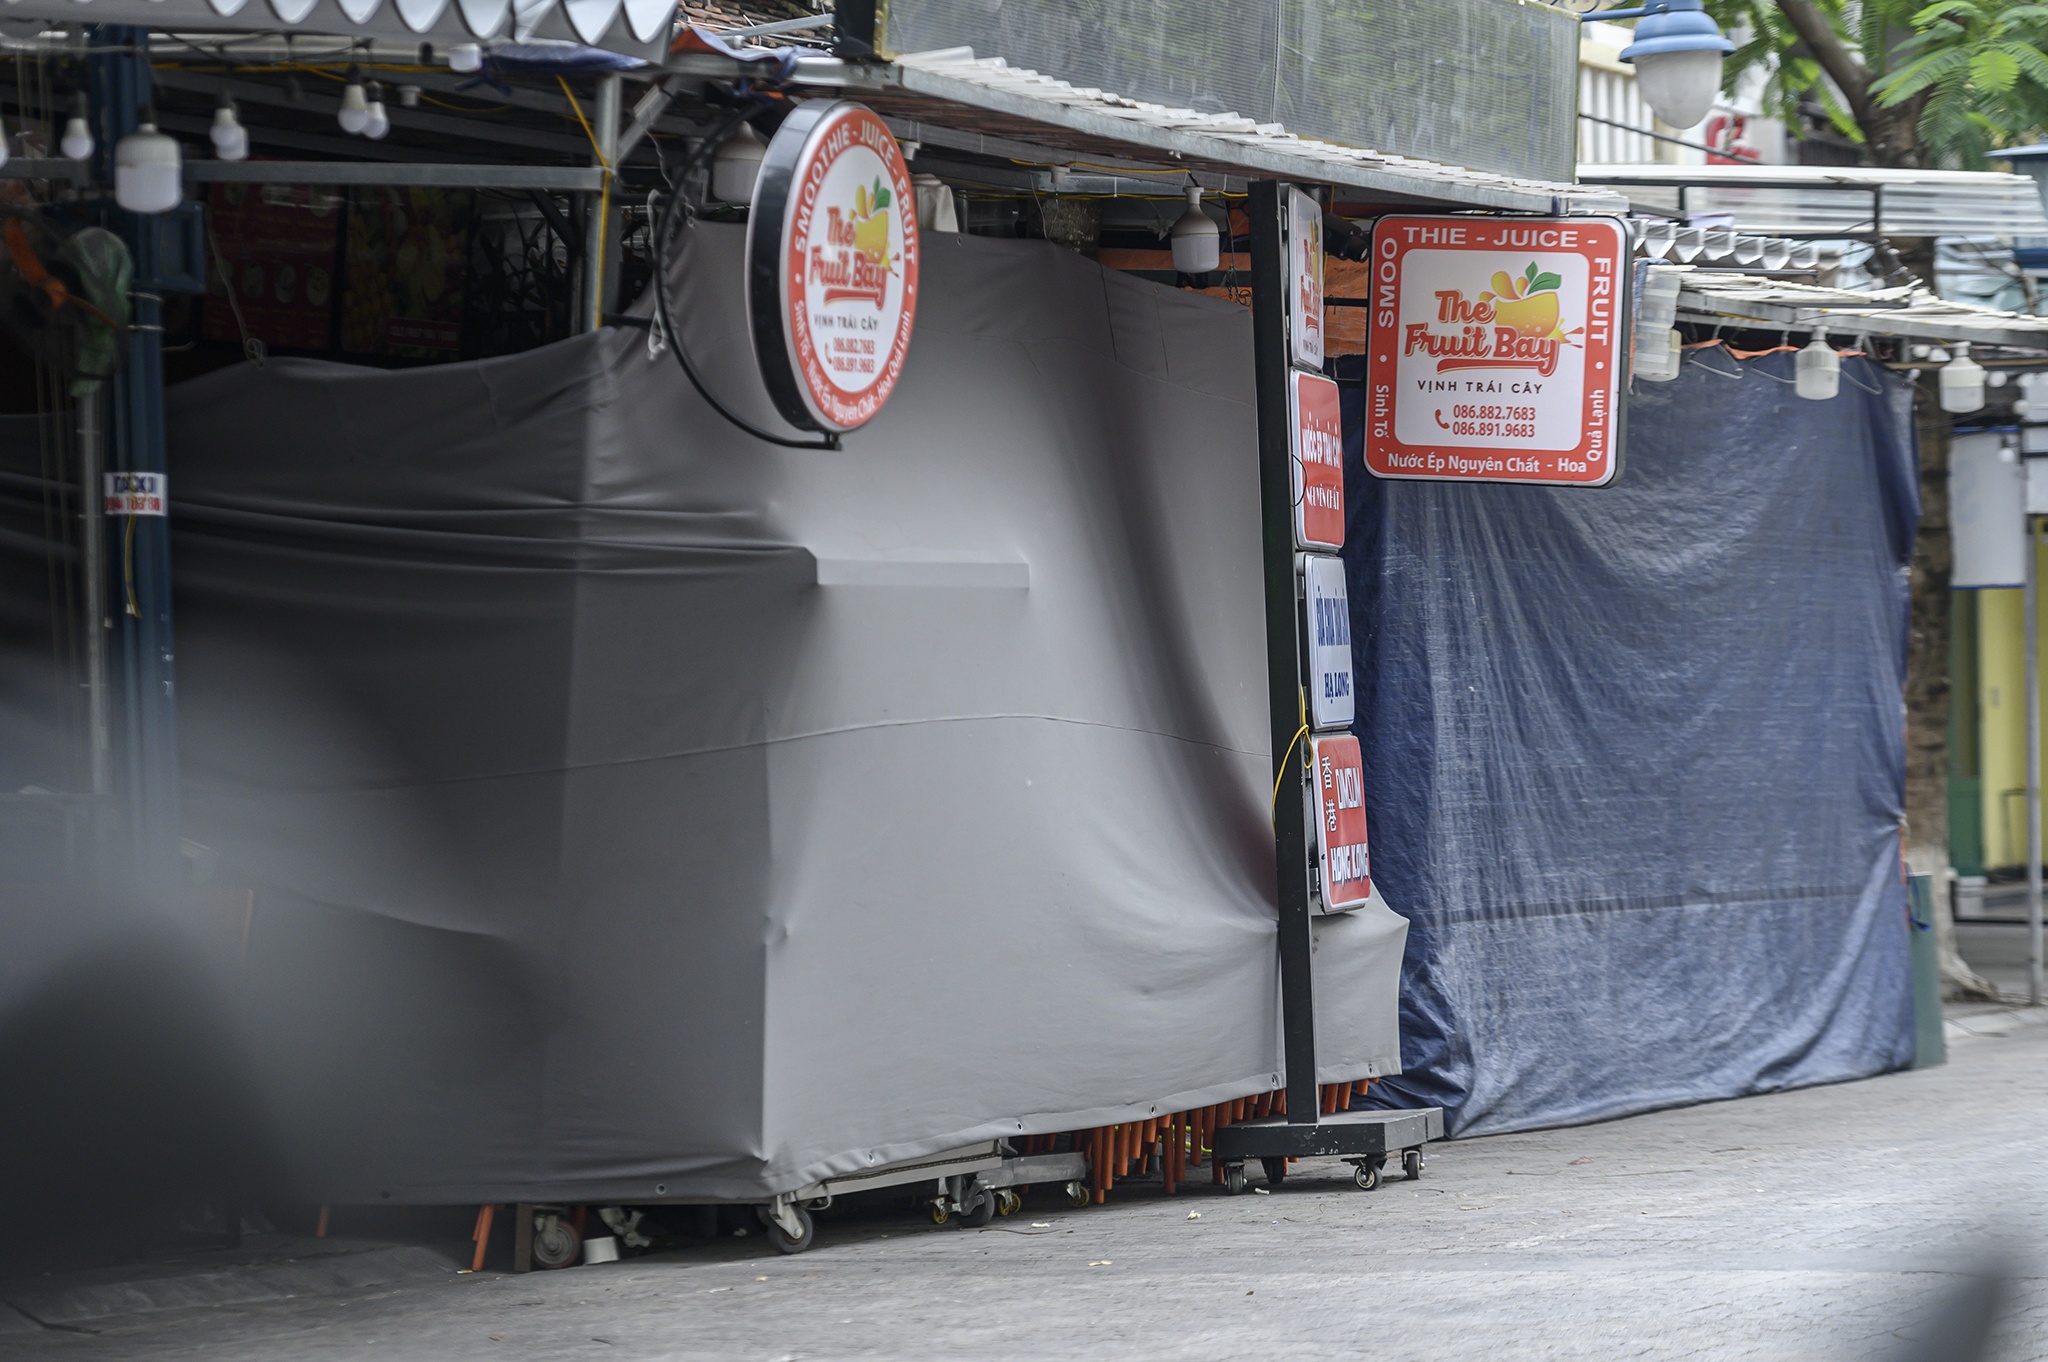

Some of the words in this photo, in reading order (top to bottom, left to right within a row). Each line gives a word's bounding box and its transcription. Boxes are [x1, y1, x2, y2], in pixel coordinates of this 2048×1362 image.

[795, 122, 850, 253] SMOOTHIE
[860, 120, 895, 167] JUICE
[896, 176, 915, 264] FRUIT
[827, 206, 856, 247] The
[1402, 226, 1467, 245] THIE
[1493, 229, 1578, 248] JUICE
[809, 245, 852, 286] Fruit
[852, 250, 887, 311] Bay
[1378, 237, 1398, 328] SMOO
[1435, 289, 1497, 324] The
[1590, 257, 1612, 346] FRUIT
[1404, 322, 1491, 357] Fruit
[1493, 326, 1559, 378] Bay
[1375, 384, 1389, 418] Sinh
[1417, 380, 1457, 393] VỊNH
[1466, 380, 1502, 393] TRÁI
[1511, 381, 1543, 394] CÂY
[1453, 404, 1536, 421] 086.882.7683
[1588, 389, 1608, 426] Lạnh
[1374, 420, 1390, 438] Tố
[1452, 421, 1535, 438] 086.891.9683
[1586, 430, 1603, 462] Quả
[1388, 453, 1424, 469] Nước
[1427, 451, 1445, 473] Ép
[1448, 456, 1503, 474] Nguyên
[1506, 456, 1540, 473] Chất
[1557, 458, 1587, 473] Hoa
[1334, 671, 1350, 698] LONG
